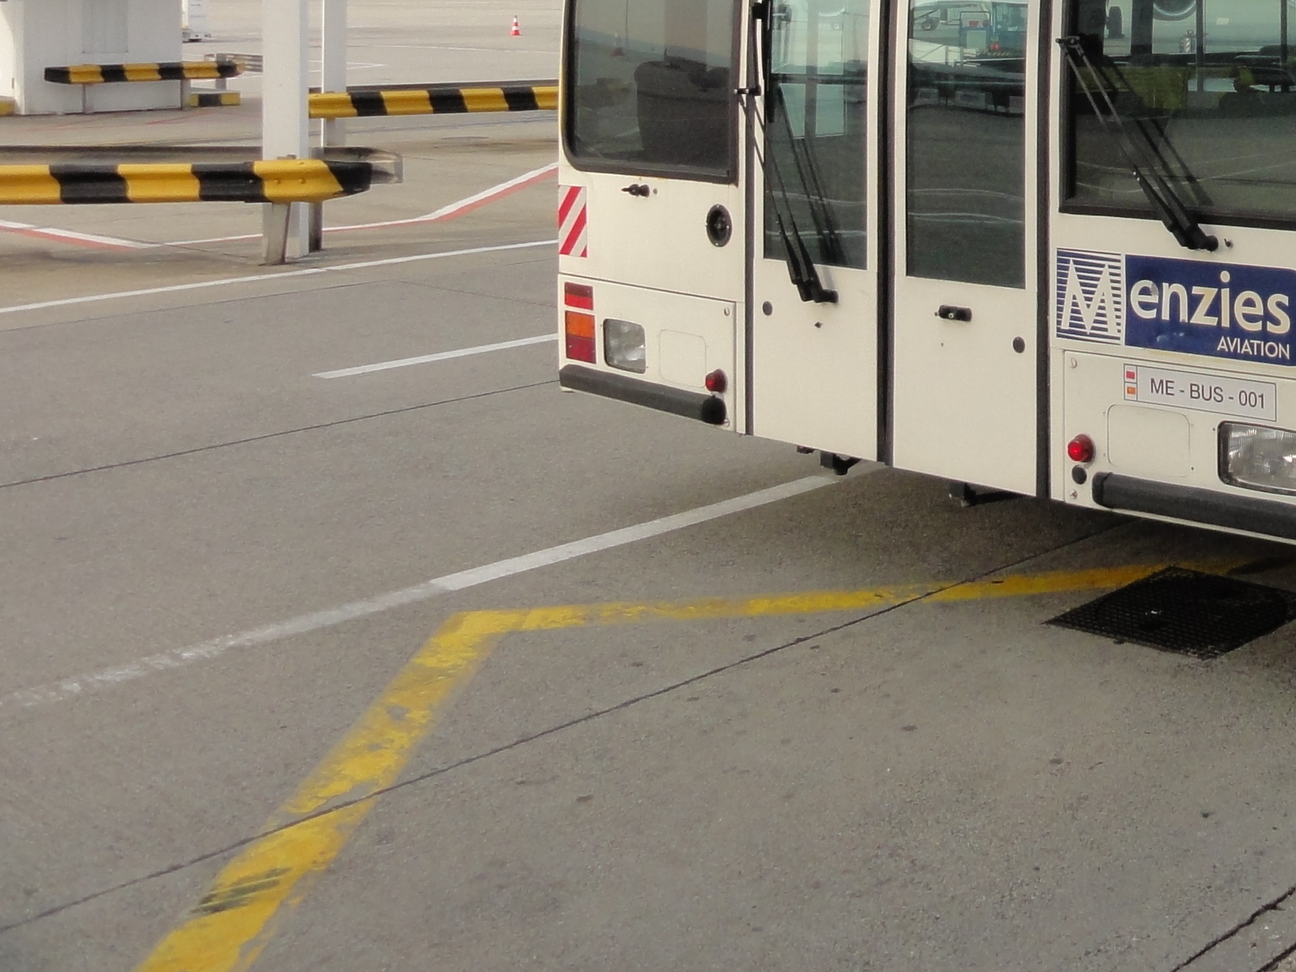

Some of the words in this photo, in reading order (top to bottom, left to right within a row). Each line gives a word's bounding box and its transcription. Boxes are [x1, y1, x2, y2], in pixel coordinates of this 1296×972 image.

[1061, 257, 1291, 334] Menzies
[1216, 335, 1290, 360] AVIATION
[1150, 377, 1175, 396] ME
[1189, 383, 1224, 403] BUS
[1238, 389, 1265, 409] 001
